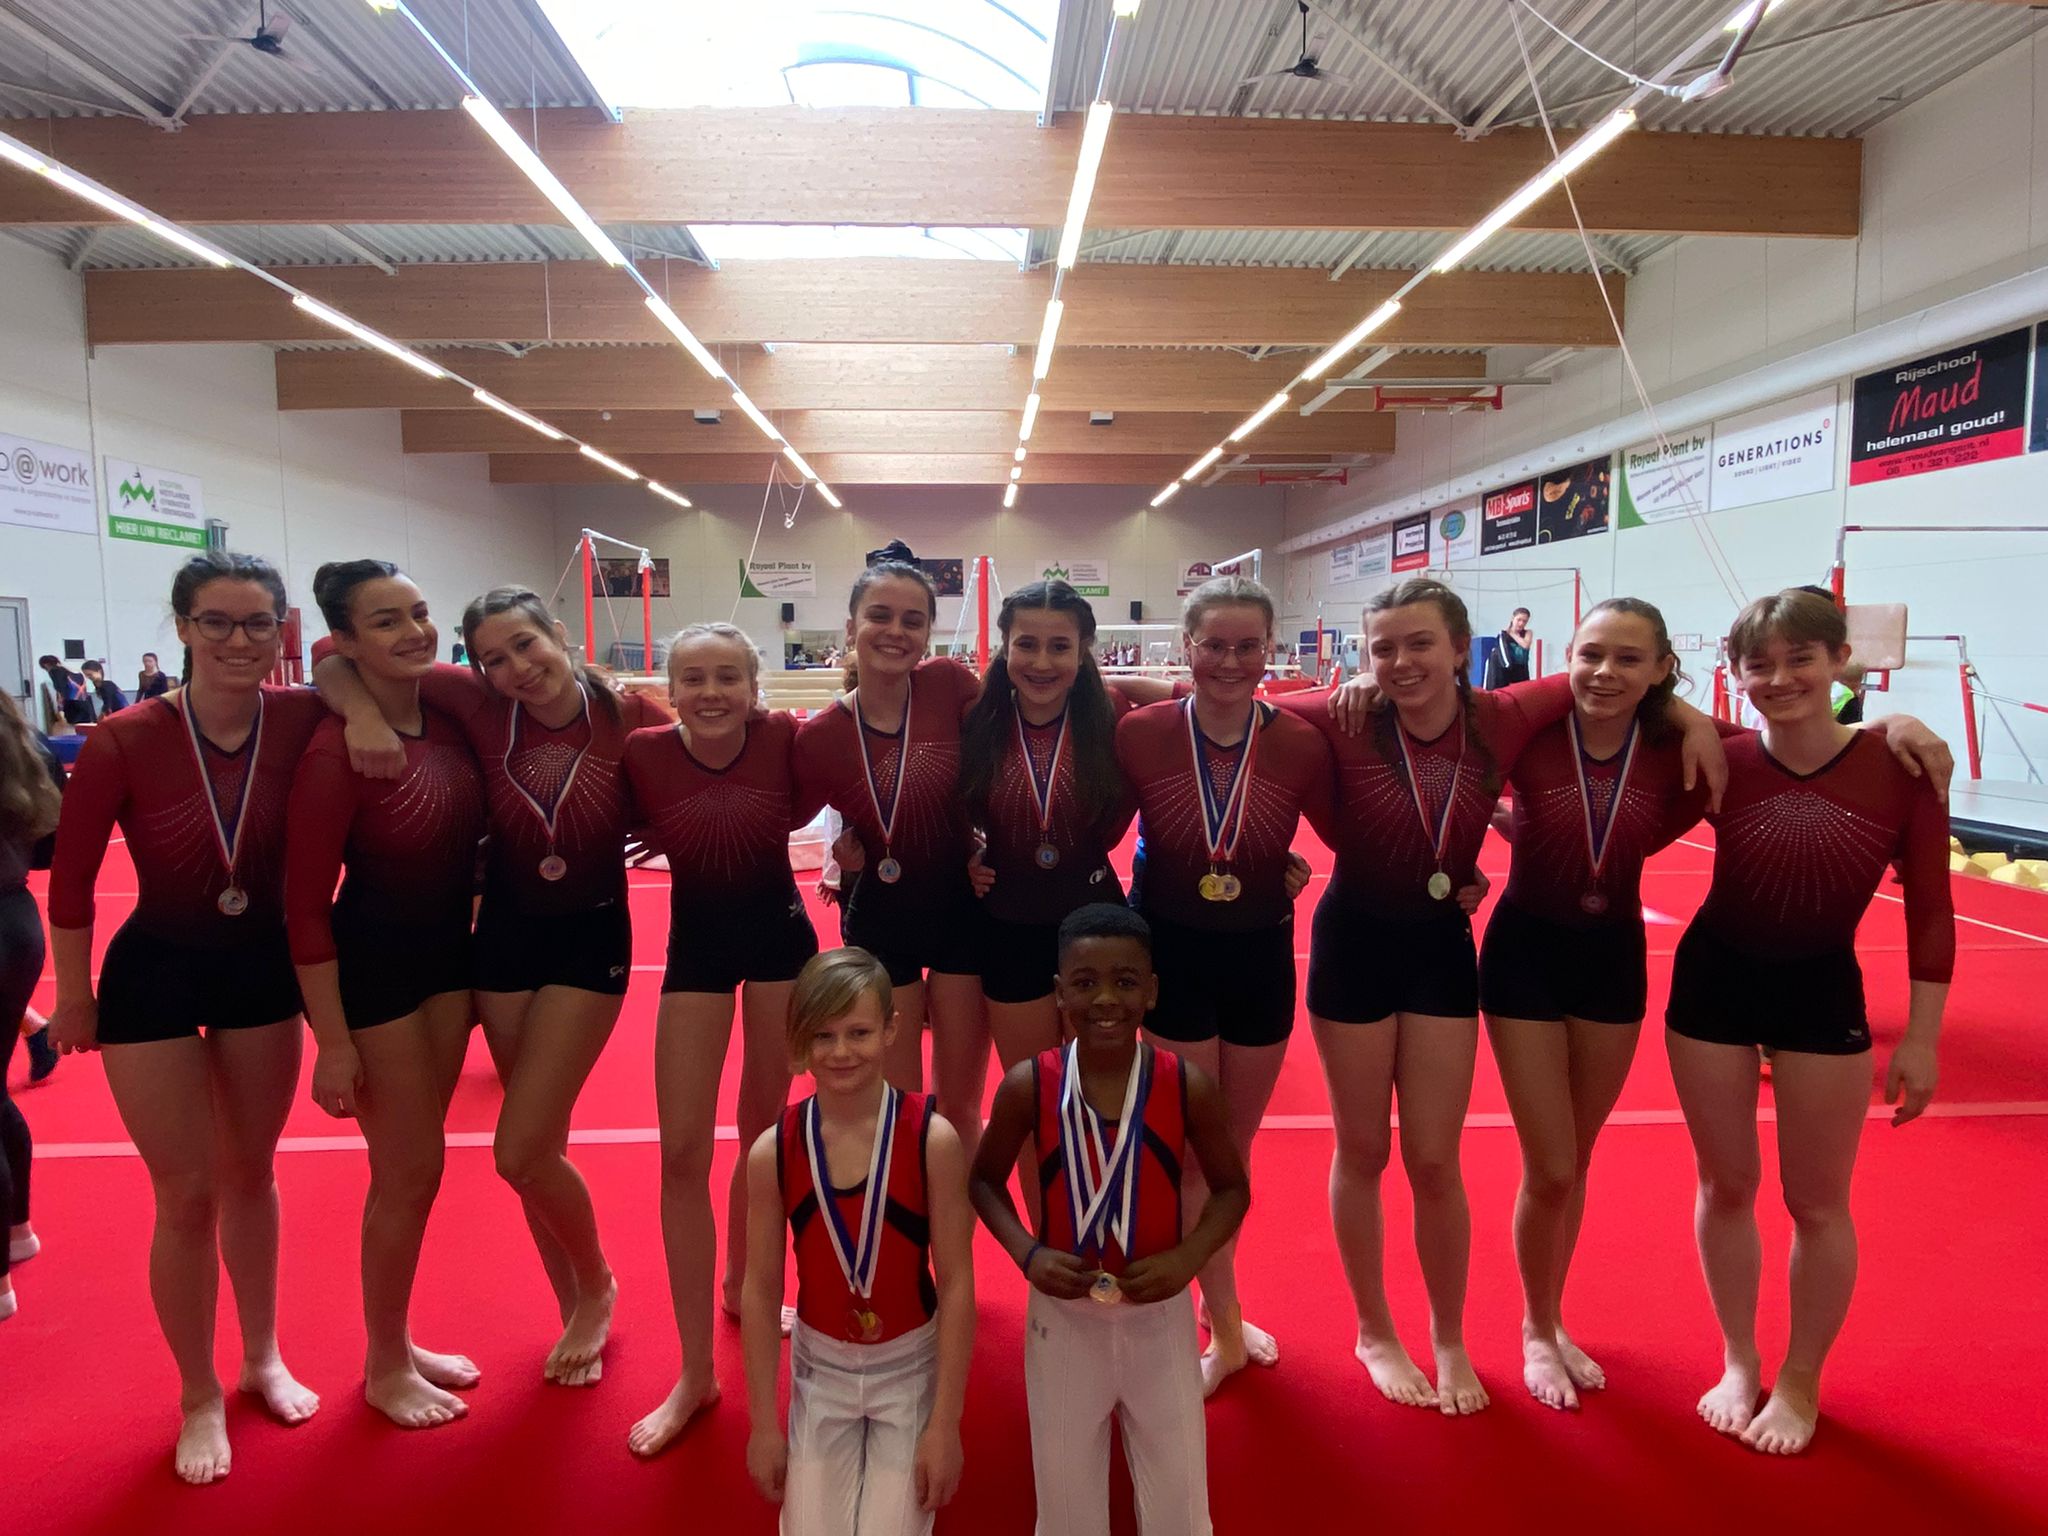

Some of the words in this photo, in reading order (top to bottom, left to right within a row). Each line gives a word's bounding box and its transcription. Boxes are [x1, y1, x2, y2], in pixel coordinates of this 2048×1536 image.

[1896, 351, 1977, 384] Rijschool
[1888, 359, 1983, 433] Maud
[1692, 435, 1705, 452] bv
[1718, 430, 1823, 468] GENERATIONS
[1866, 425, 1944, 452] helemaal
[1950, 411, 2005, 436] goud!
